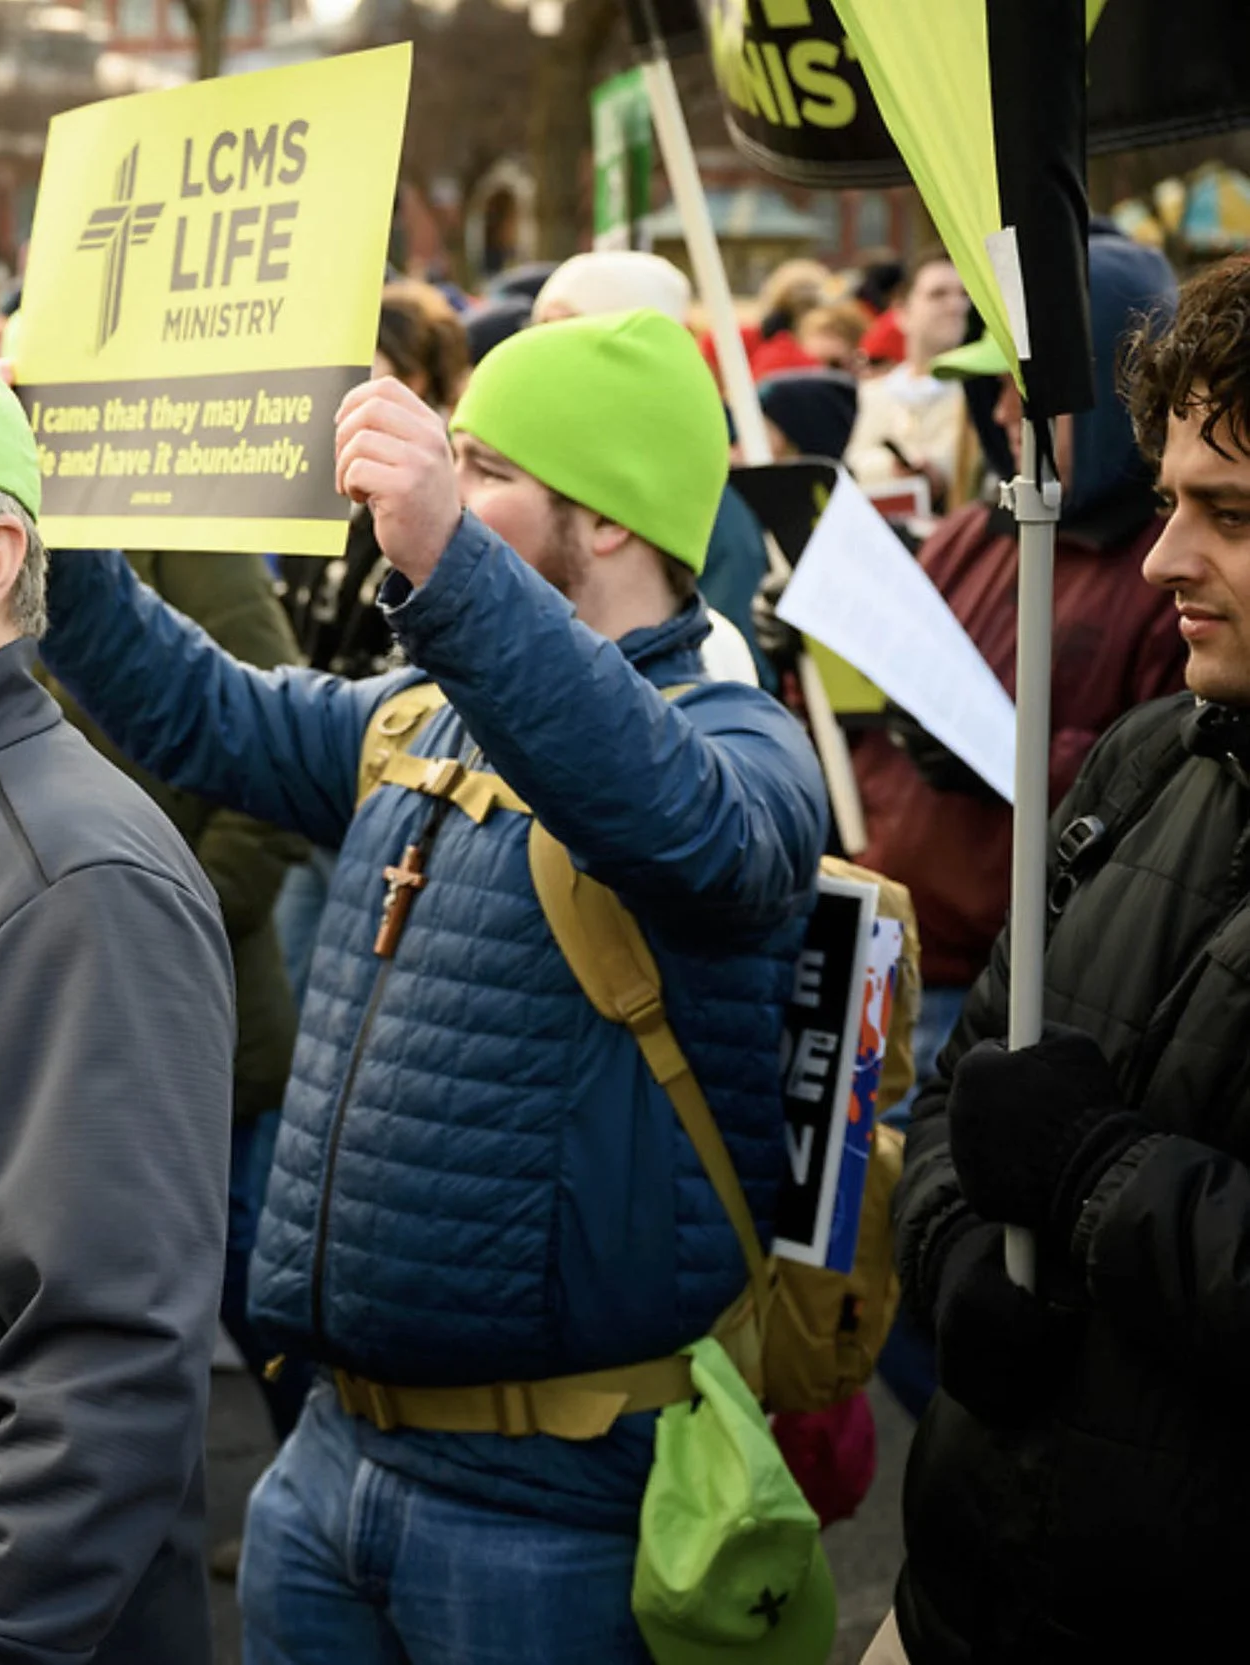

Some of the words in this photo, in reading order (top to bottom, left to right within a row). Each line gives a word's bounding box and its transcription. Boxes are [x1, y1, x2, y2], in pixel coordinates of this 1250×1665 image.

[180, 118, 309, 199] LCMS
[169, 201, 299, 292] LIFE
[162, 297, 285, 342] MINISTRY
[31, 402, 41, 432] I
[43, 404, 99, 433] came
[103, 397, 148, 431] that
[151, 394, 200, 434] they
[202, 398, 252, 432] may
[255, 389, 312, 425] have
[58, 443, 100, 476] and
[100, 442, 151, 476] have
[153, 441, 172, 475] it
[174, 437, 309, 480] abundantly.
